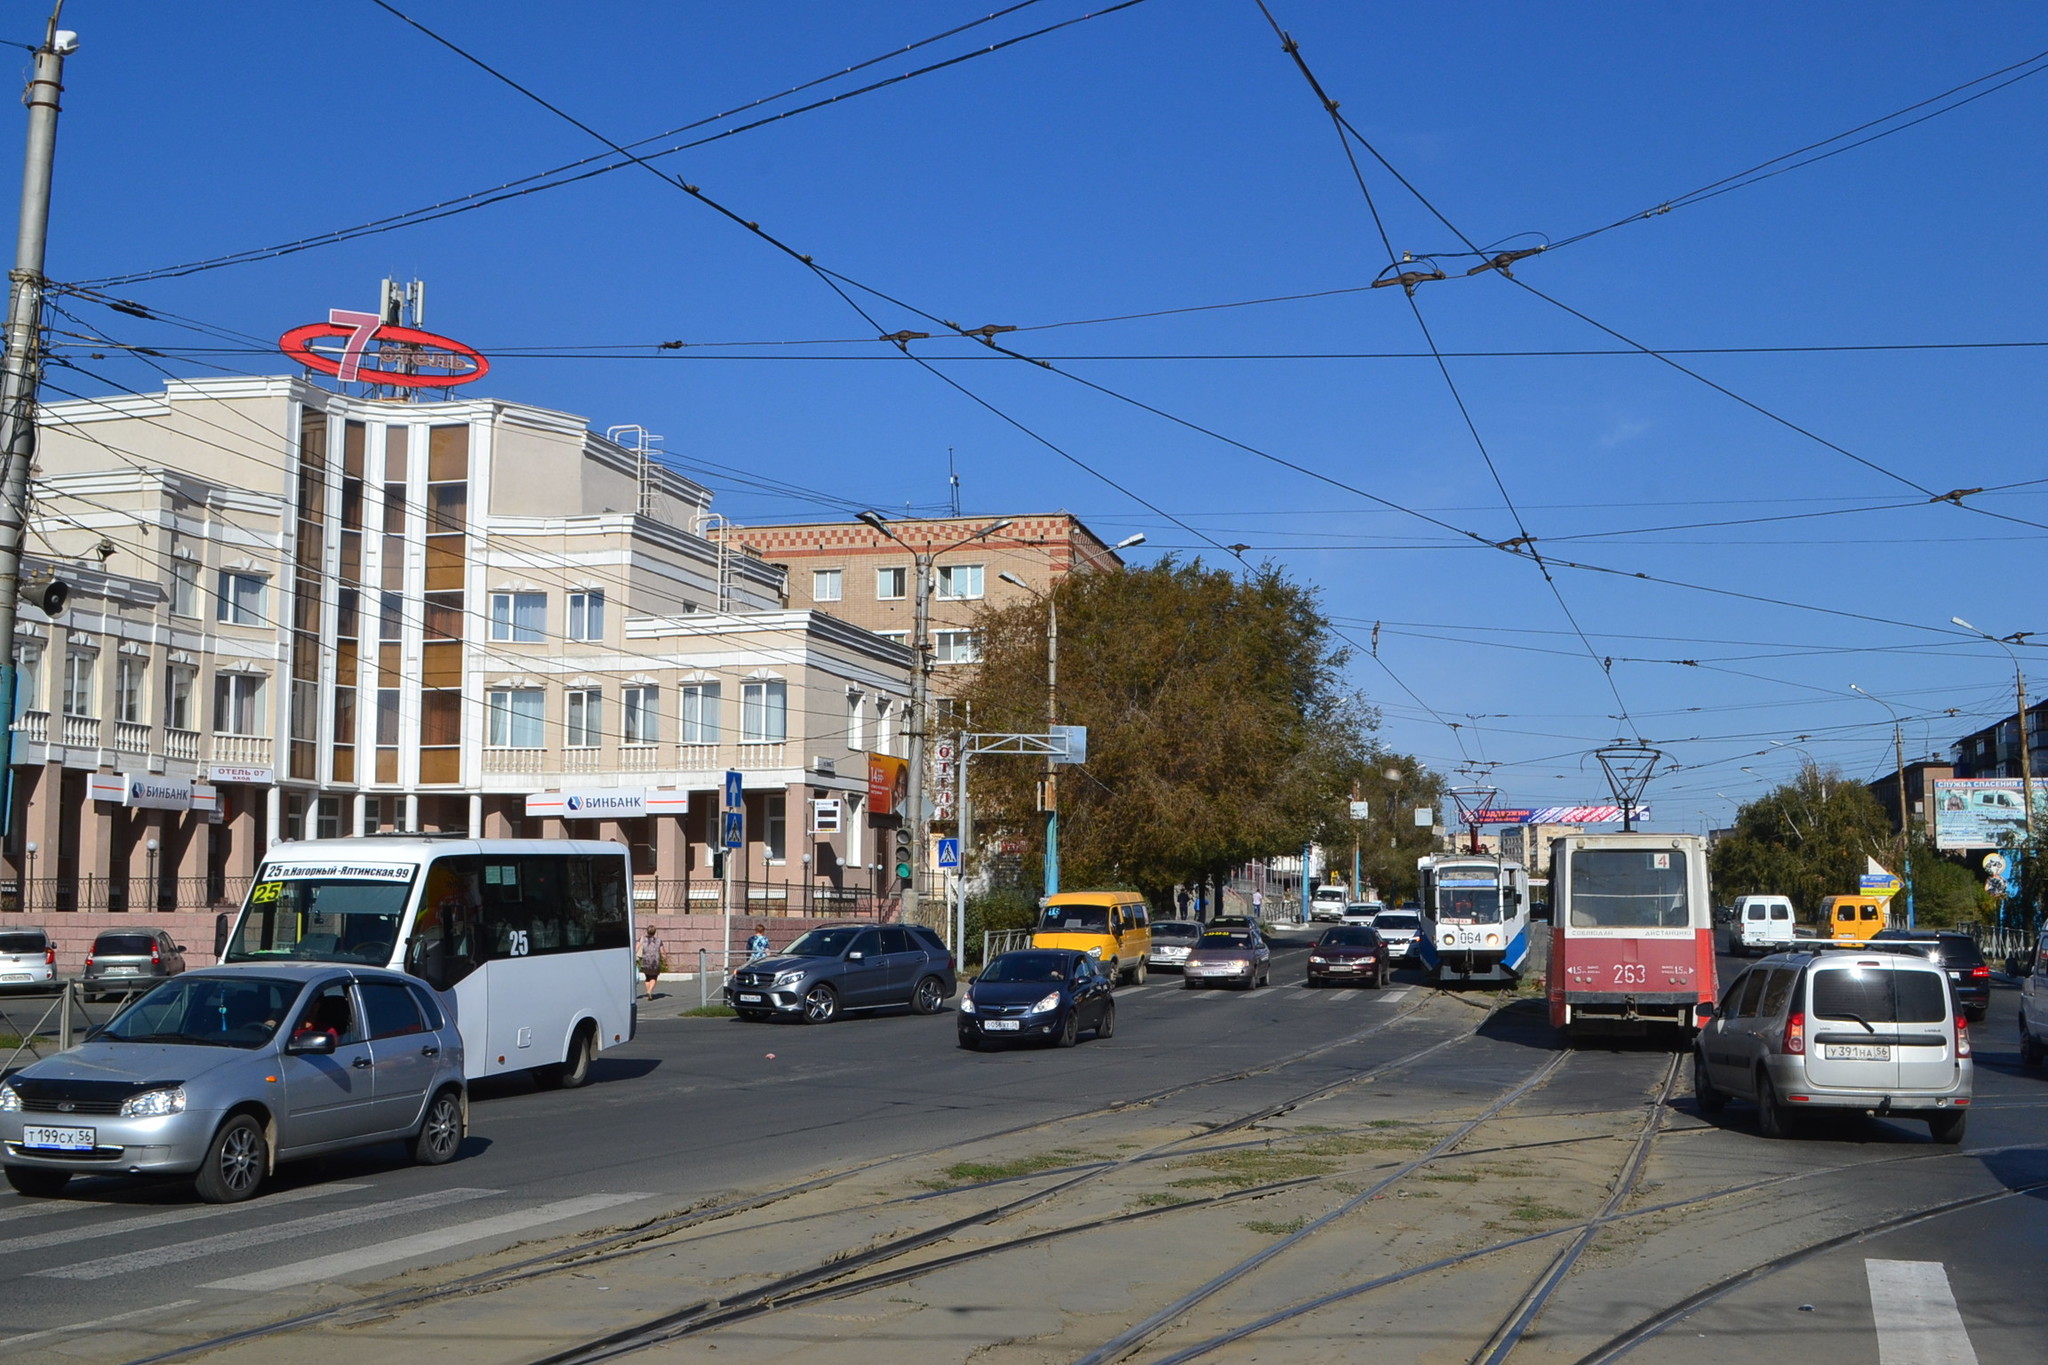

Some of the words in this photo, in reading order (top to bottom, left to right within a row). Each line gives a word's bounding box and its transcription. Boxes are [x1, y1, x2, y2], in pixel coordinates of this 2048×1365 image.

[329, 308, 381, 382] 7
[218, 768, 251, 776] ОТЕЛЬ
[146, 786, 188, 800] БИНБАНК
[585, 797, 641, 808] БИНБАНК
[1657, 855, 1667, 867] 4
[267, 865, 283, 877] 25
[255, 886, 279, 901] 25
[509, 930, 528, 955] 25
[1460, 932, 1481, 944] 064
[1613, 965, 1646, 983] 263
[1876, 1047, 1887, 1056] 56
[79, 1131, 92, 1141] 56
